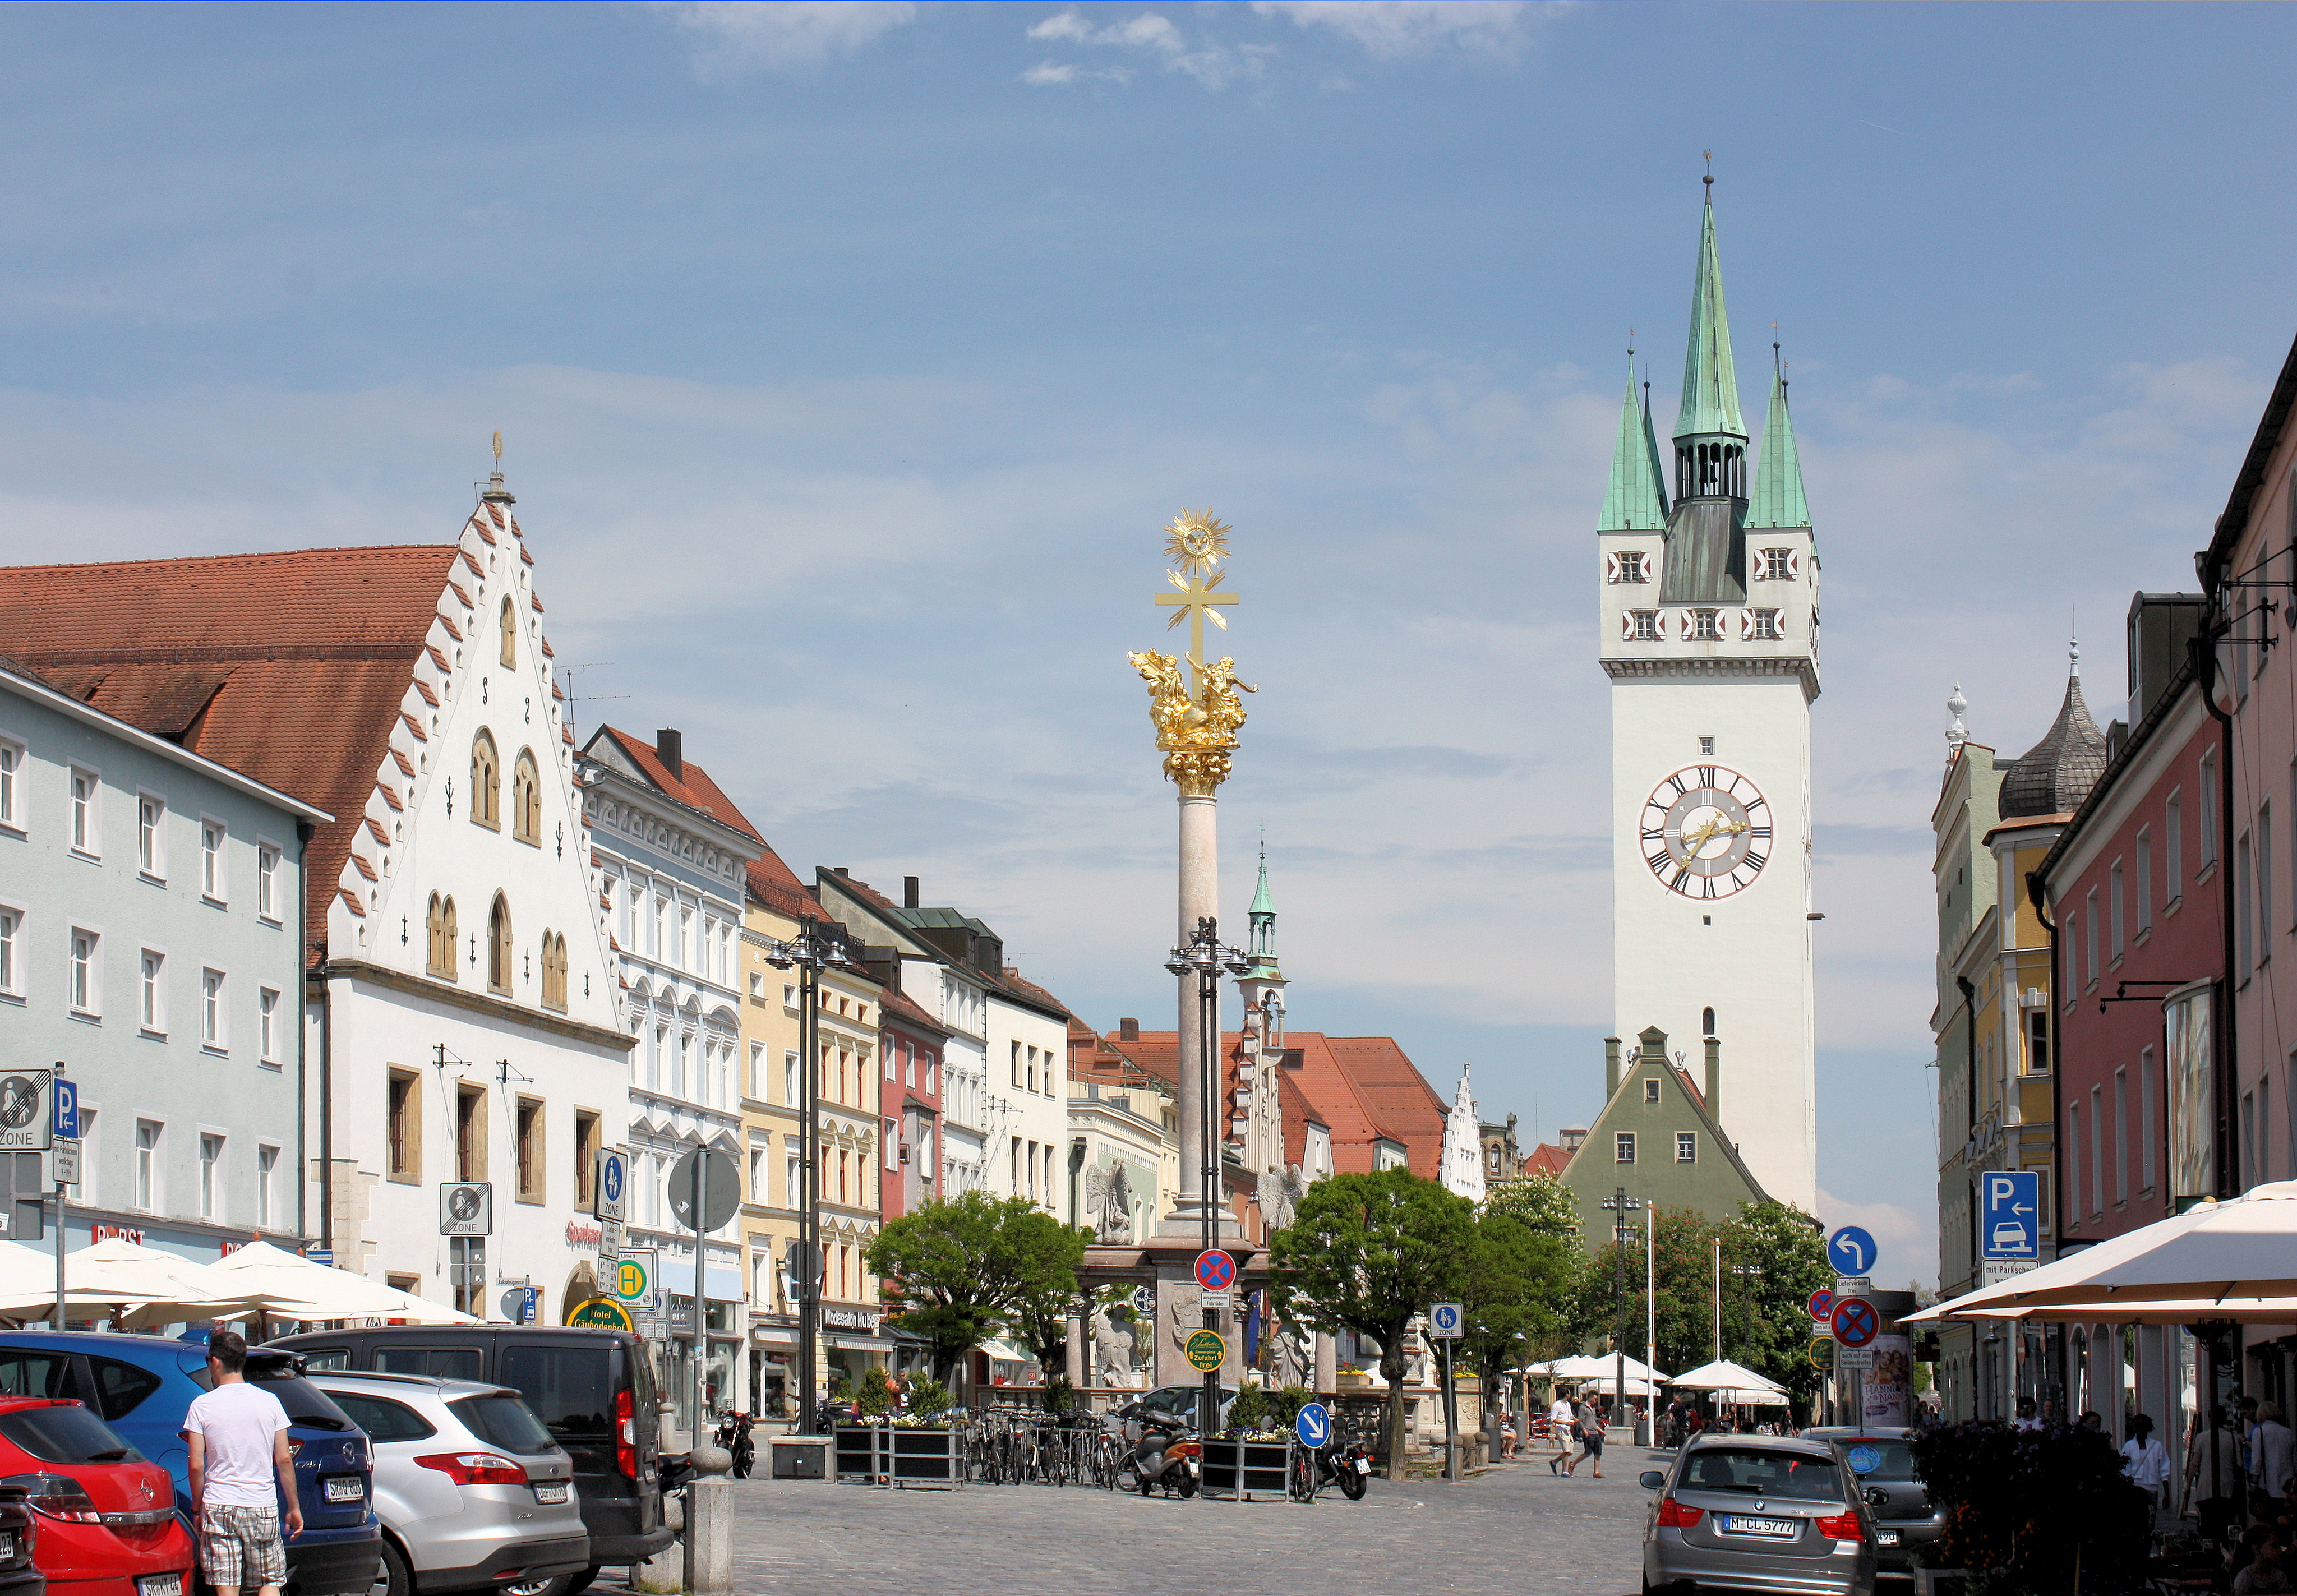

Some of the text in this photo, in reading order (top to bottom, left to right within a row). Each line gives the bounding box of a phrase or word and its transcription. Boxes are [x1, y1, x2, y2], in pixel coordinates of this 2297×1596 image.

[1698, 767, 1715, 788] XII
[59, 1086, 72, 1128] P
[0, 1133, 33, 1145] ZONE
[1992, 1178, 2014, 1211] P
[605, 1203, 619, 1216] ZONE
[453, 1224, 477, 1232] ZONE
[621, 1269, 636, 1291] H
[525, 1289, 531, 1302] P
[591, 1310, 611, 1318] Hotel
[825, 1308, 856, 1327] Modesalon
[1865, 1385, 1895, 1395] HANNI
[1880, 1393, 1903, 1403] NANN
[1731, 1517, 1793, 1532] M CL 5777
[1878, 1532, 1895, 1540] 490
[0, 1535, 12, 1555] 23
[146, 1579, 155, 1596] SR
